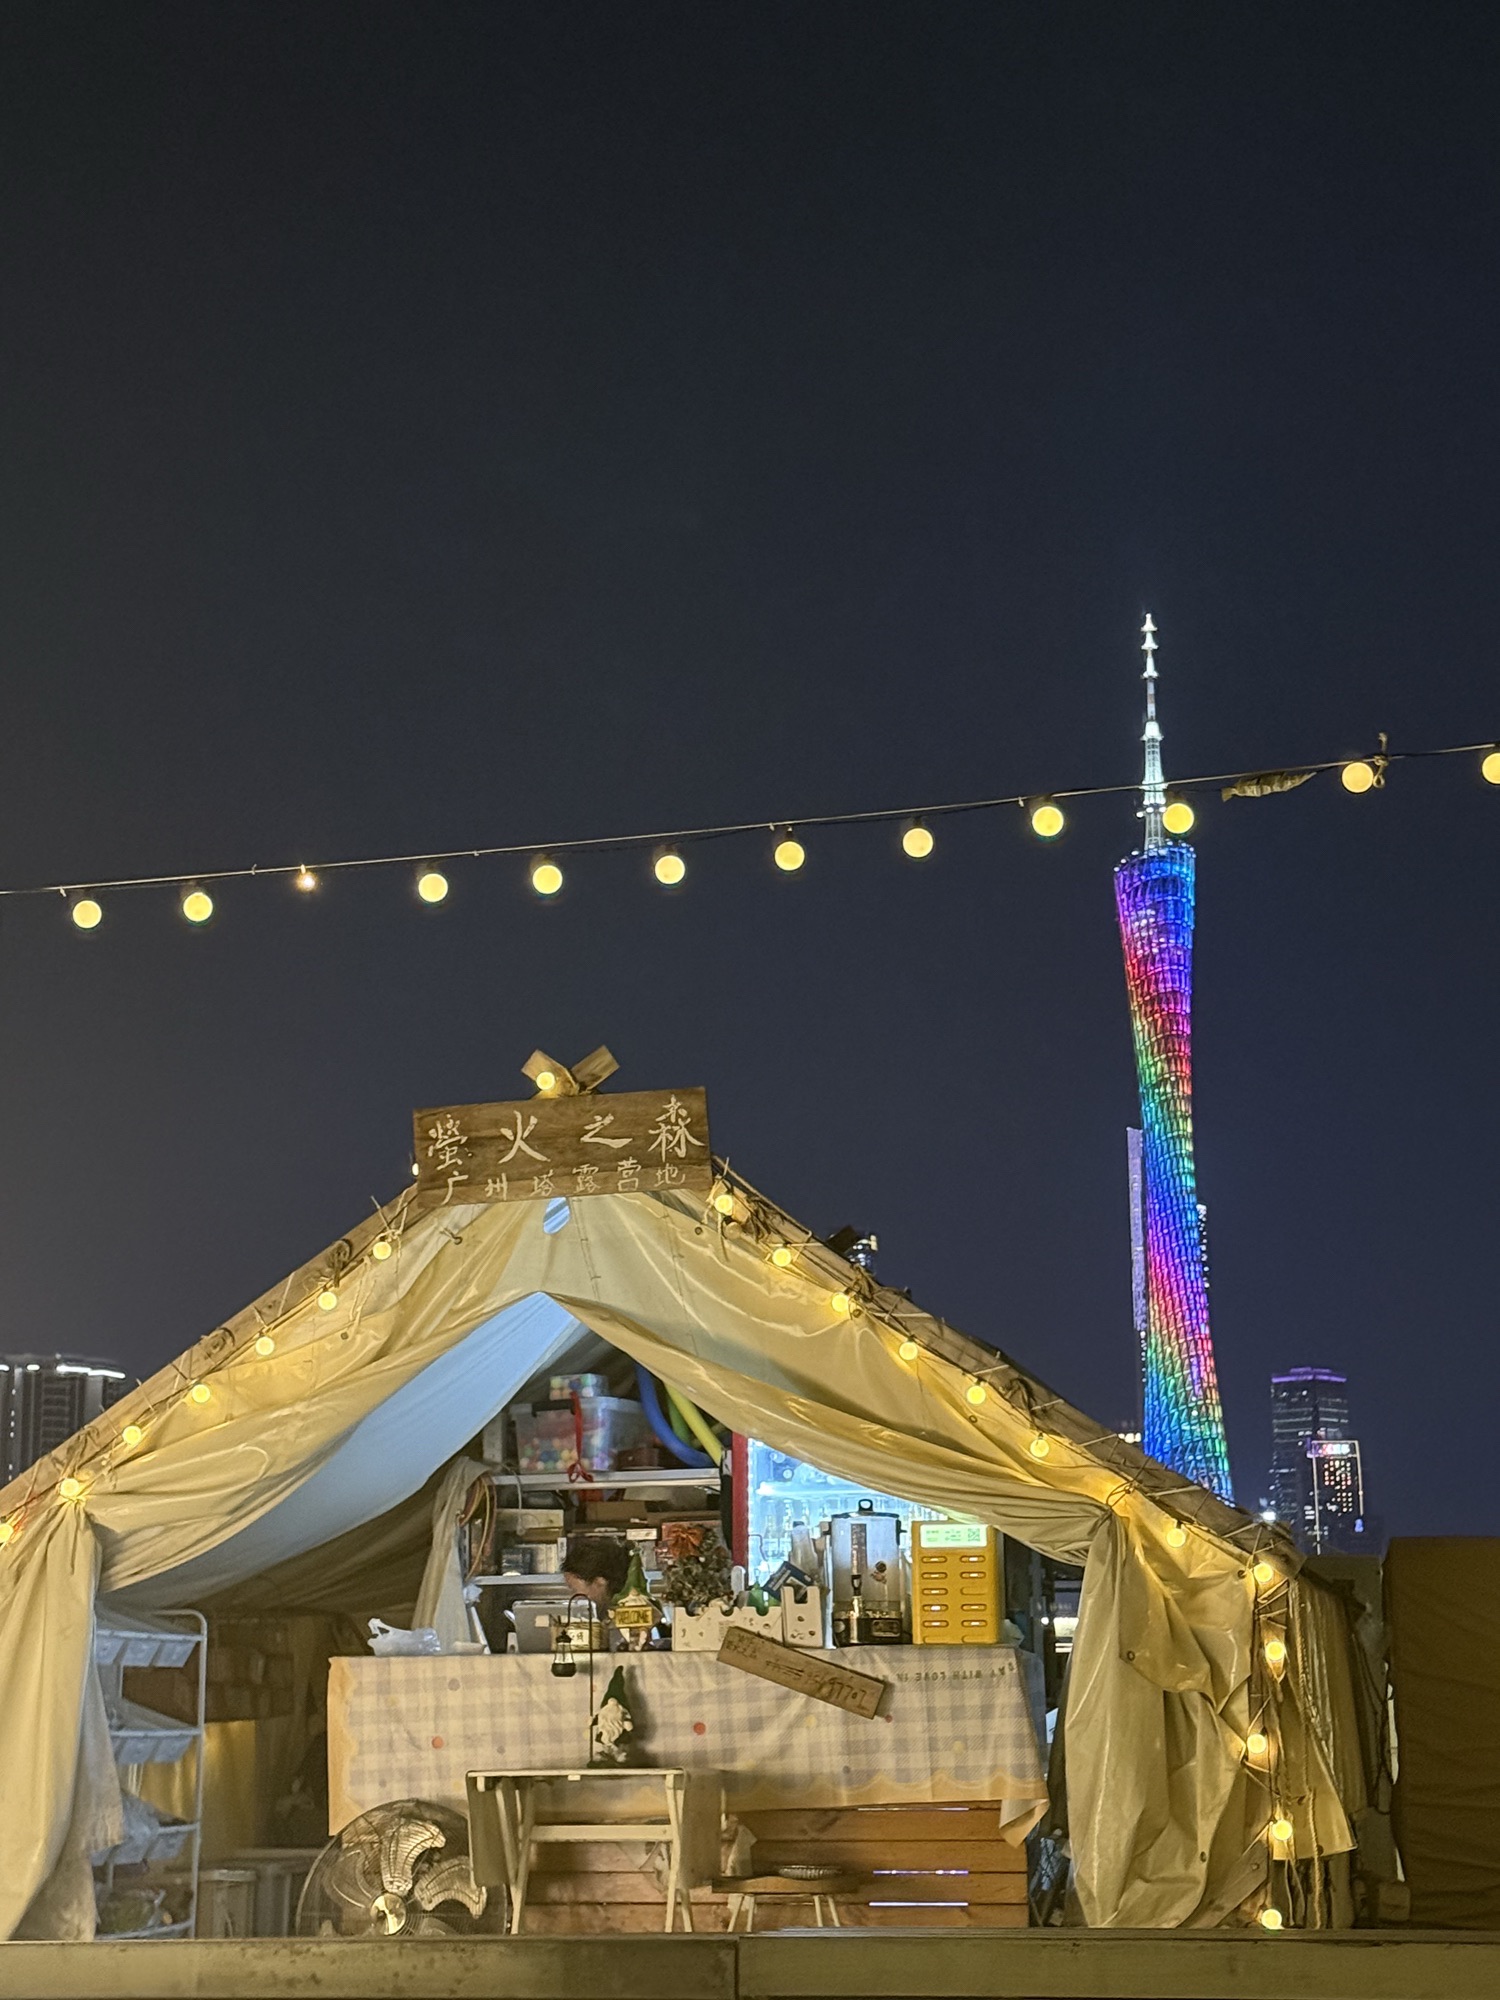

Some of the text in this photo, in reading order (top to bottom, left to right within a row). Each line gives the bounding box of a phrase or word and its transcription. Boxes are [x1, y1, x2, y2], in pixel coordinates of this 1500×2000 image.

[440, 1156, 686, 1206] 广州塔露营地
[617, 1610, 650, 1625] WELCOME
[915, 1671, 946, 1682] LOVE
